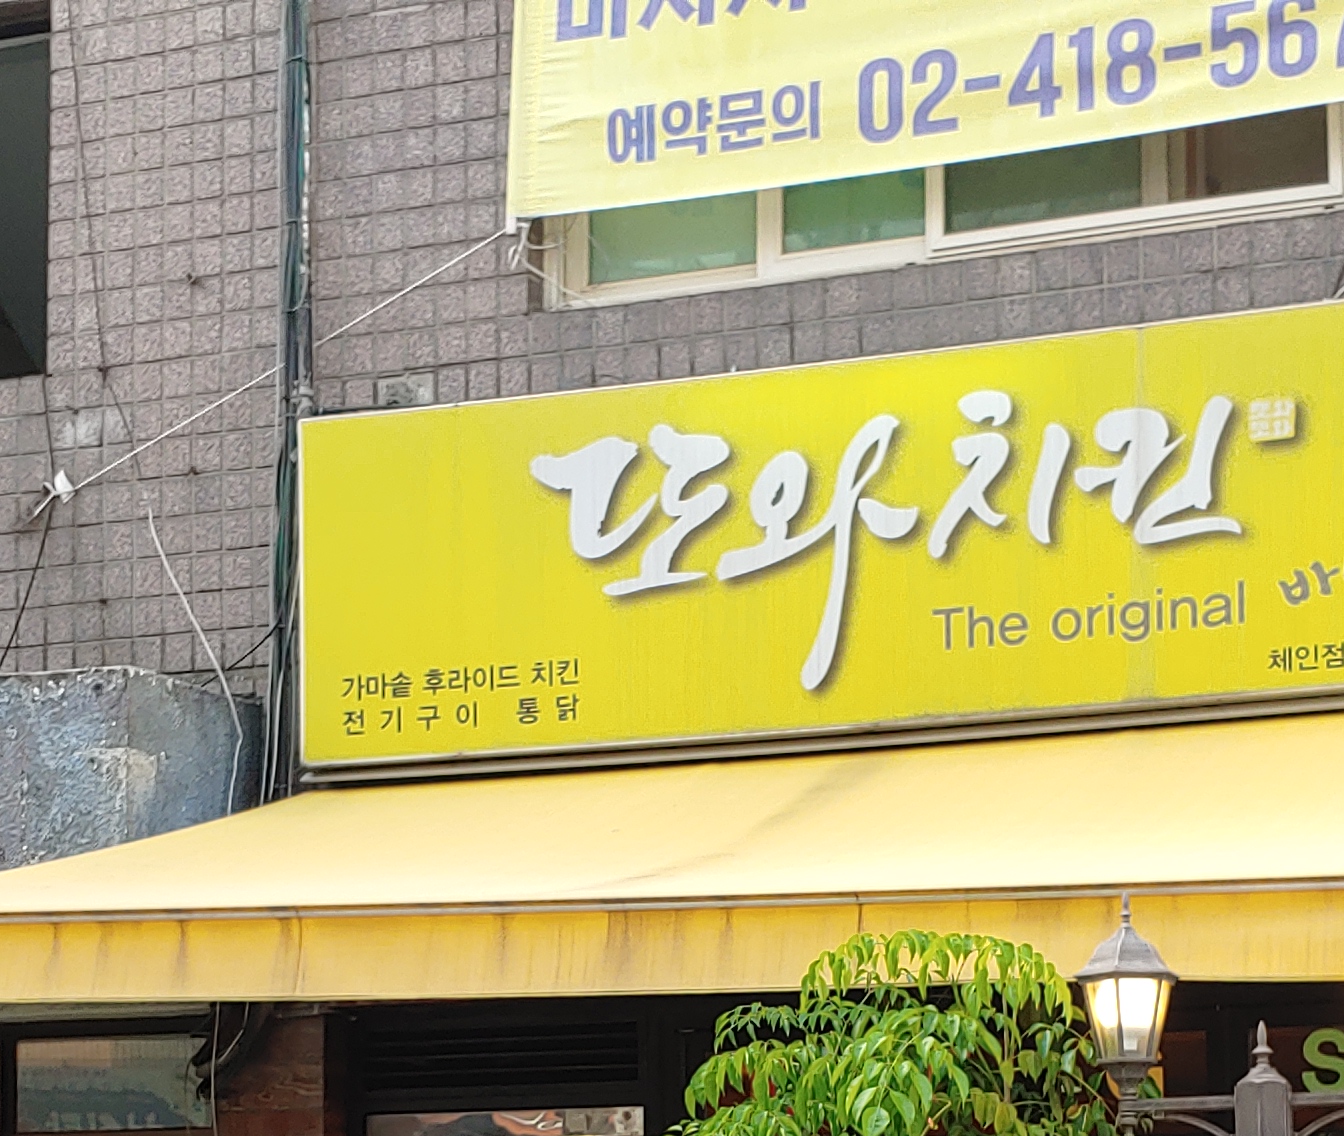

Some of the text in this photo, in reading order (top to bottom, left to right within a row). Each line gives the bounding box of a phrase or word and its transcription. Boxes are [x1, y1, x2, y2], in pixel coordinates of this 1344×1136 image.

[607, 80, 822, 164] 예약문의
[932, 580, 1248, 652] The original
[341, 657, 581, 702] 가마솥 후라이드 치킨
